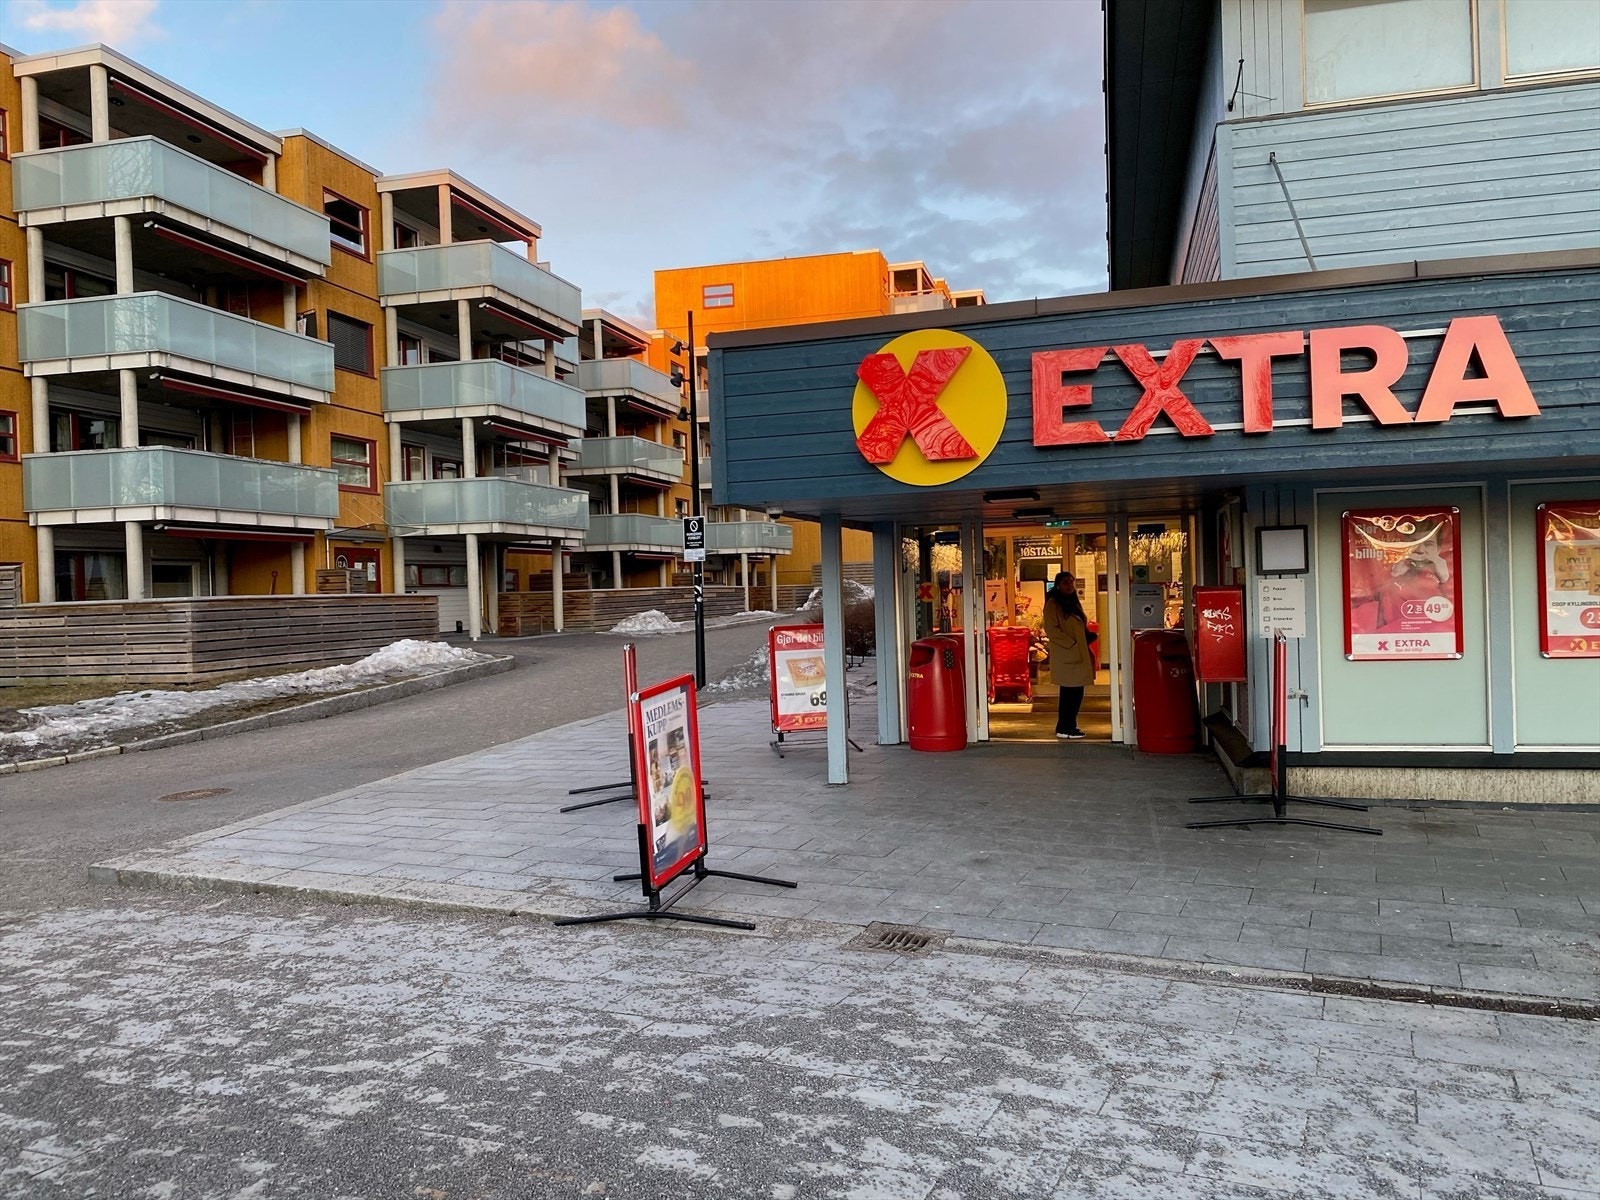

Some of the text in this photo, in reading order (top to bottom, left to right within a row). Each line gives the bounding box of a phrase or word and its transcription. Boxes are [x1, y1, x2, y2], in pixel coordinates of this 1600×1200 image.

[1031, 315, 1541, 448] EXTRA
[1406, 603, 1414, 615] 2
[776, 634, 795, 645] Gjør
[1395, 639, 1431, 647] EXTRA
[647, 718, 668, 739] KUPP
